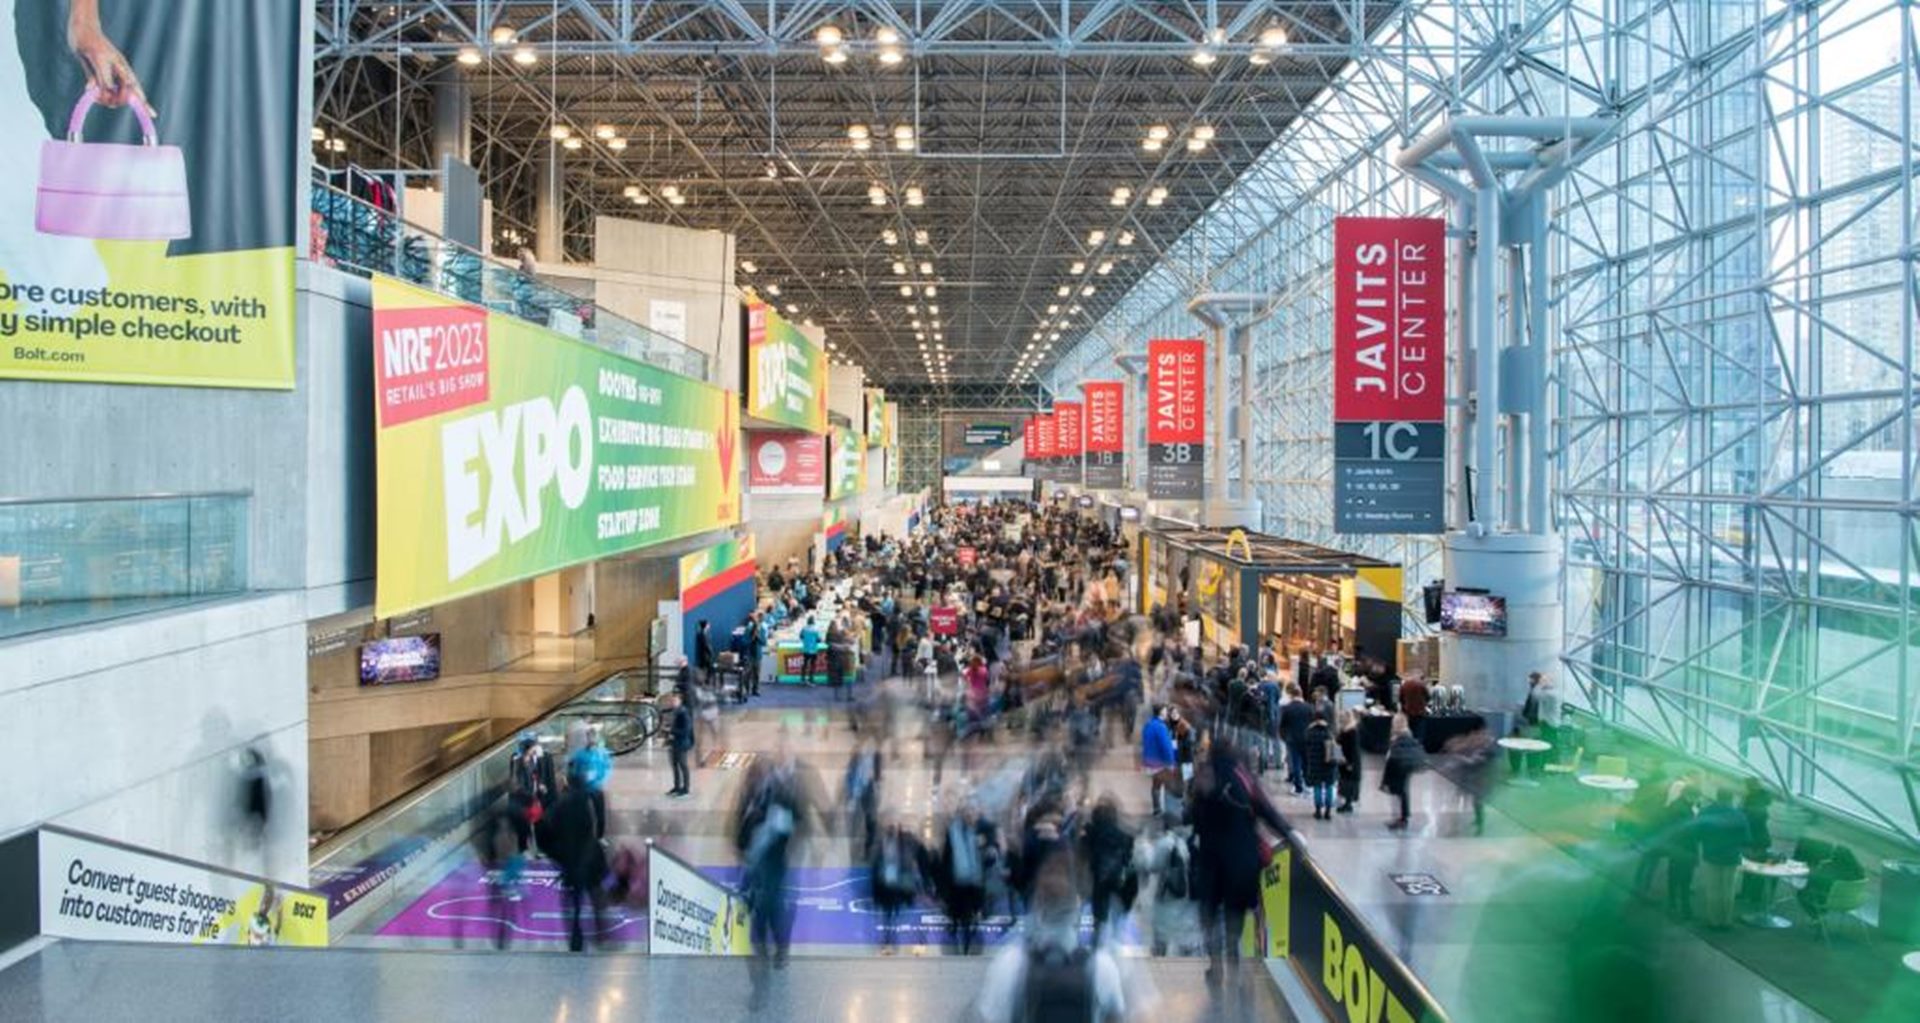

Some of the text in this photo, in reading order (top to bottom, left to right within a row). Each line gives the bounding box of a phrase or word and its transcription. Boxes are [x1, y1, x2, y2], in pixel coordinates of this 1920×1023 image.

[24, 309, 116, 339] simple
[122, 316, 242, 344] checkout
[51, 286, 205, 318] customers,
[211, 296, 266, 319] with
[1355, 243, 1388, 392] JAVITS
[1401, 243, 1426, 395] CENTER
[14, 346, 85, 363] Bolt.com
[439, 376, 457, 395] BIG
[1158, 353, 1176, 430] JAVITS
[1183, 353, 1196, 430] CENTER
[1091, 391, 1105, 442] JAVITS
[1363, 421, 1419, 460] 1C
[1162, 443, 1191, 464] 3B
[442, 384, 593, 583] EXPO
[68, 859, 238, 917] Convert guest shoppers
[59, 889, 220, 939] into customers for life
